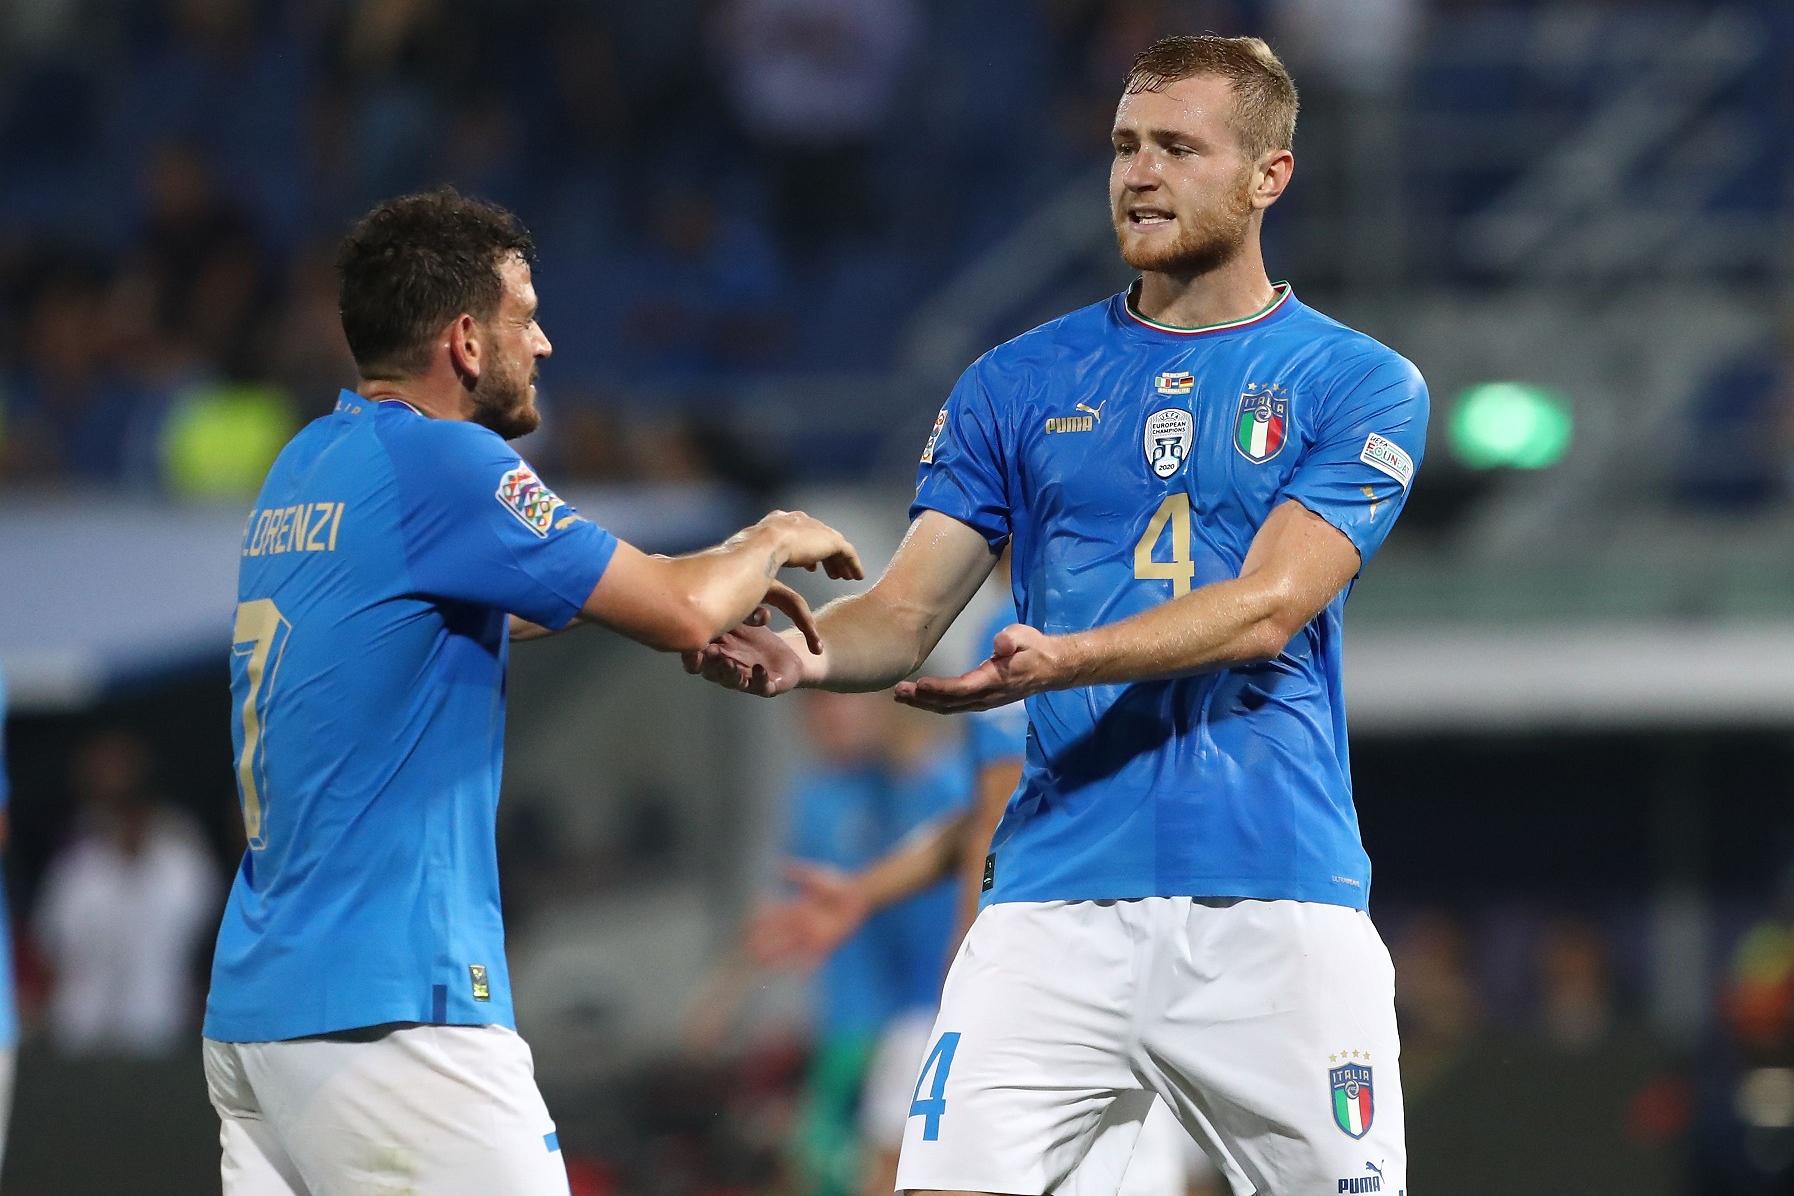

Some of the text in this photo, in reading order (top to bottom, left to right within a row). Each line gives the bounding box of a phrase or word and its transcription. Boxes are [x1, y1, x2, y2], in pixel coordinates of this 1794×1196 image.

[1245, 396, 1284, 414] ITALIA
[1046, 416, 1092, 434] PUMA
[1159, 412, 1179, 420] UEFA
[1370, 436, 1388, 447] UEFA
[1134, 492, 1194, 599] 4
[232, 598, 291, 851] 7
[1332, 1069, 1370, 1083] ITALIA
[908, 1032, 962, 1141] 4
[1338, 1176, 1381, 1194] PUMA
